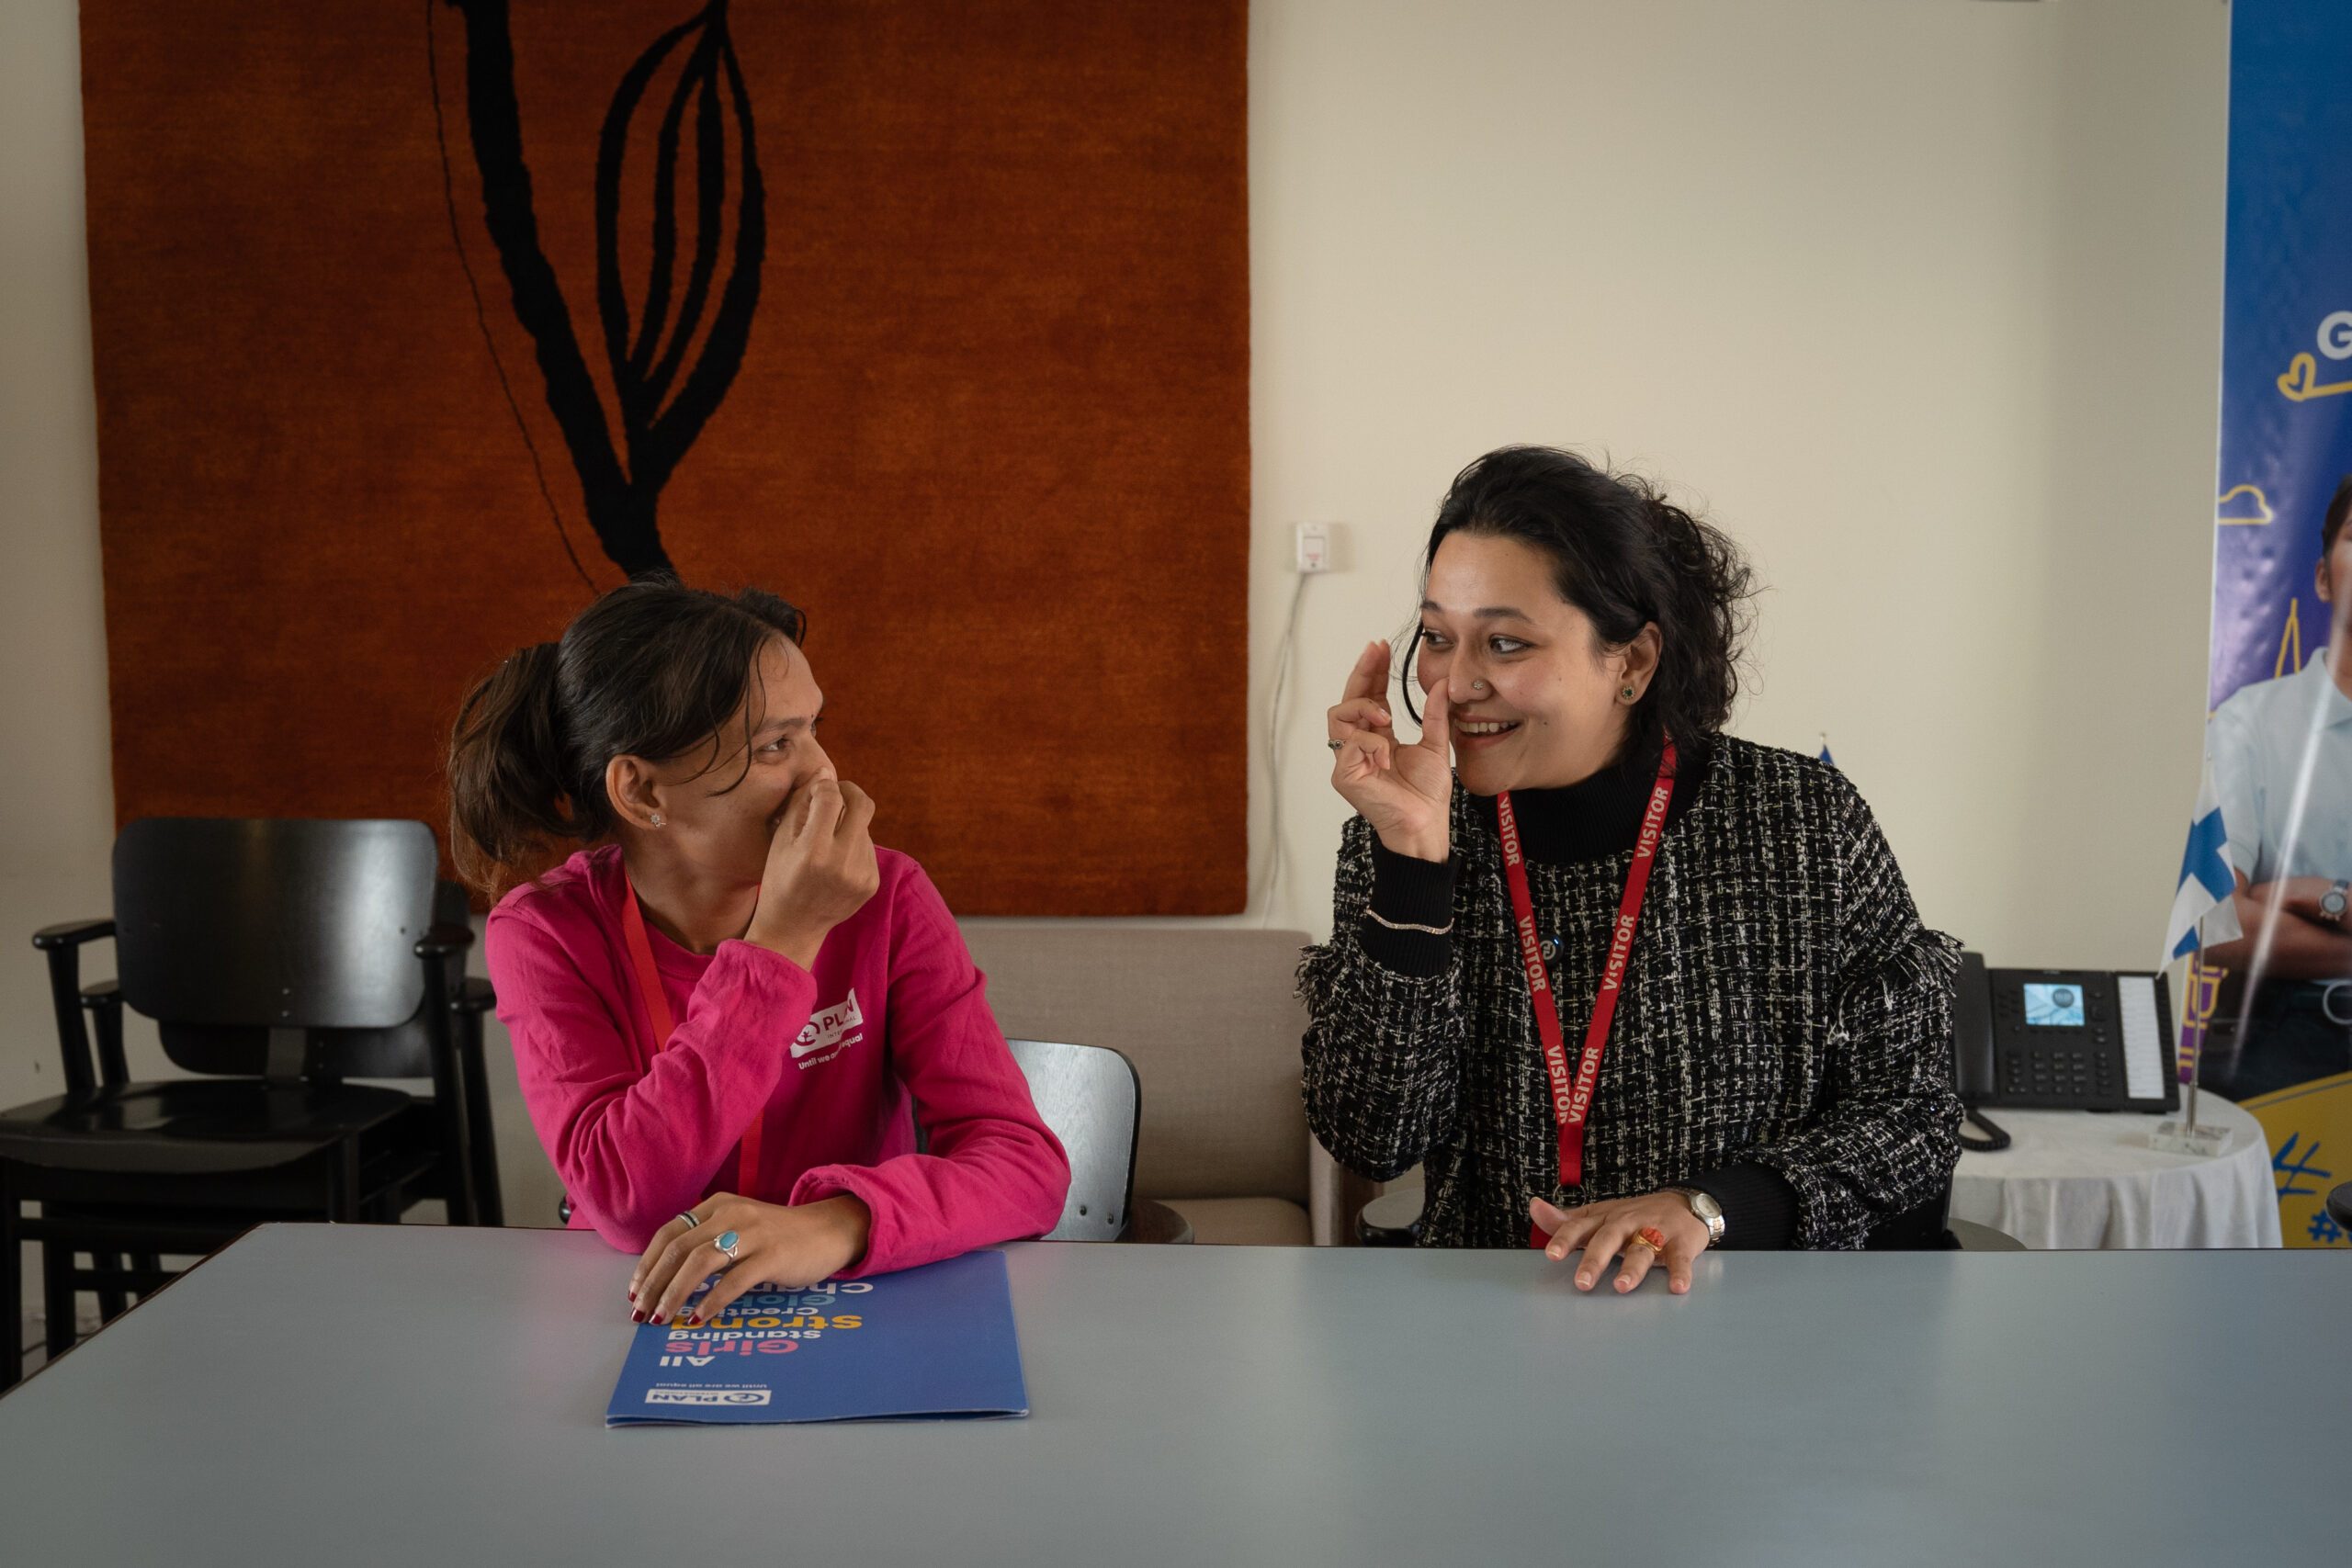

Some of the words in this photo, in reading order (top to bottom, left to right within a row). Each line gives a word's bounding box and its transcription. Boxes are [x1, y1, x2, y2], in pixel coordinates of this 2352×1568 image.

[1499, 796, 1521, 866] VISITOR
[1637, 786, 1668, 858] VISITOR
[1519, 915, 1546, 992] VISITOR
[1603, 914, 1634, 990] VISITOR
[798, 1057, 817, 1069] Until
[818, 1055, 830, 1064] we
[1568, 1046, 1600, 1123] VISITOR
[659, 1355, 716, 1367] All
[665, 1339, 798, 1356] Girls
[652, 1394, 718, 1403] PLAN
